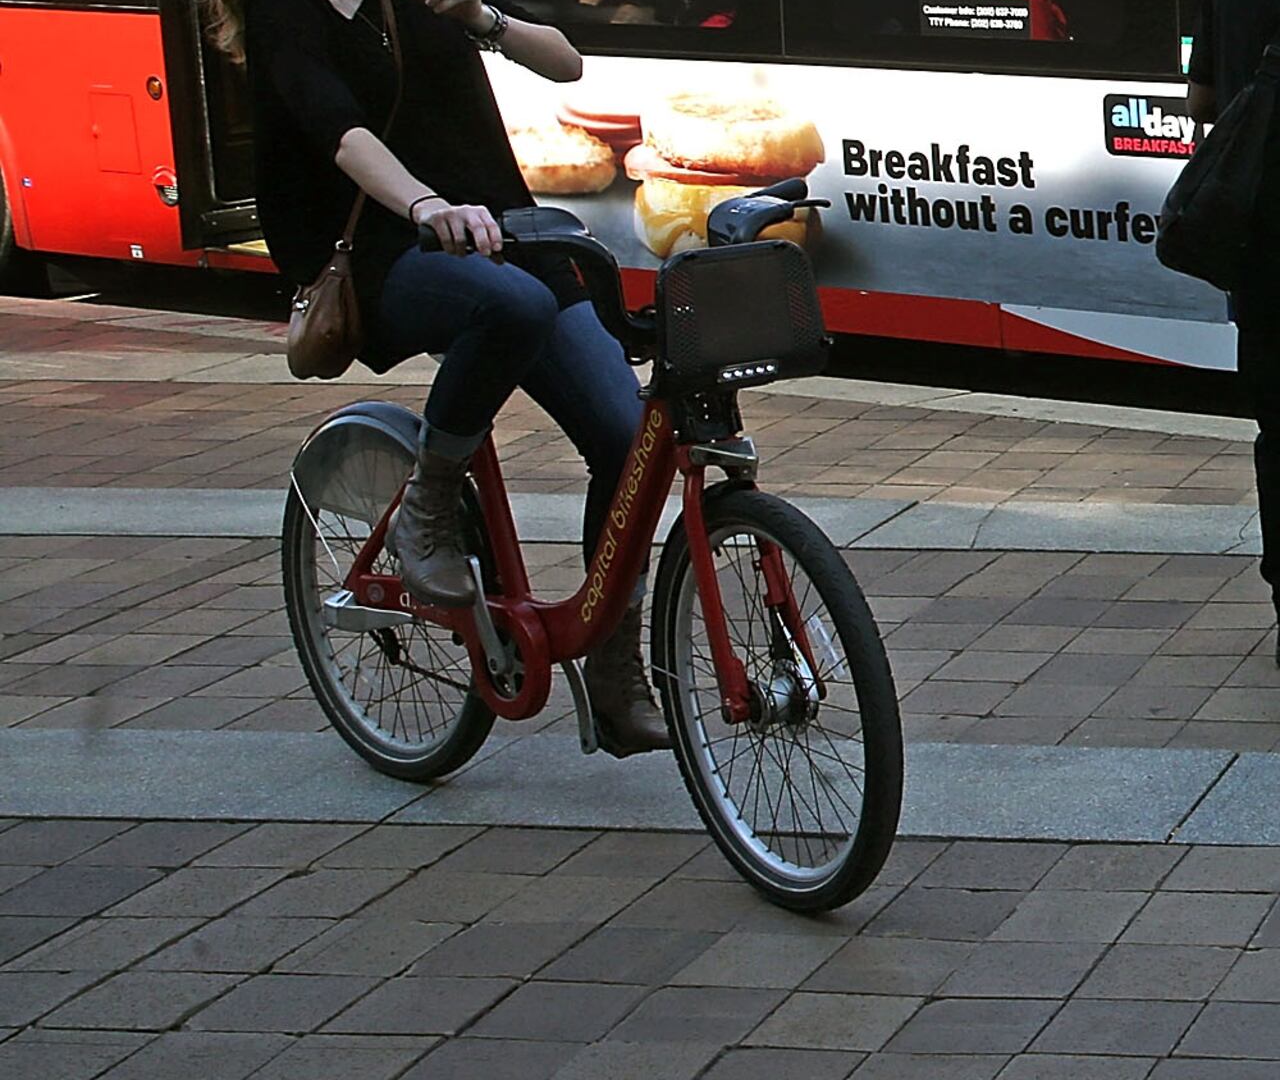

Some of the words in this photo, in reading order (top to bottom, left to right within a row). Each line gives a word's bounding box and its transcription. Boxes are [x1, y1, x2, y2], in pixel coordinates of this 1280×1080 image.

[1111, 98, 1147, 128] all
[1144, 106, 1196, 145] day
[1113, 136, 1195, 155] BREAKFAST
[842, 139, 1036, 189] Breakfast
[844, 184, 998, 233] without
[1008, 203, 1034, 236] a
[1045, 201, 1161, 245] curfe
[581, 528, 618, 624] capital
[611, 409, 663, 530] bikeshare
